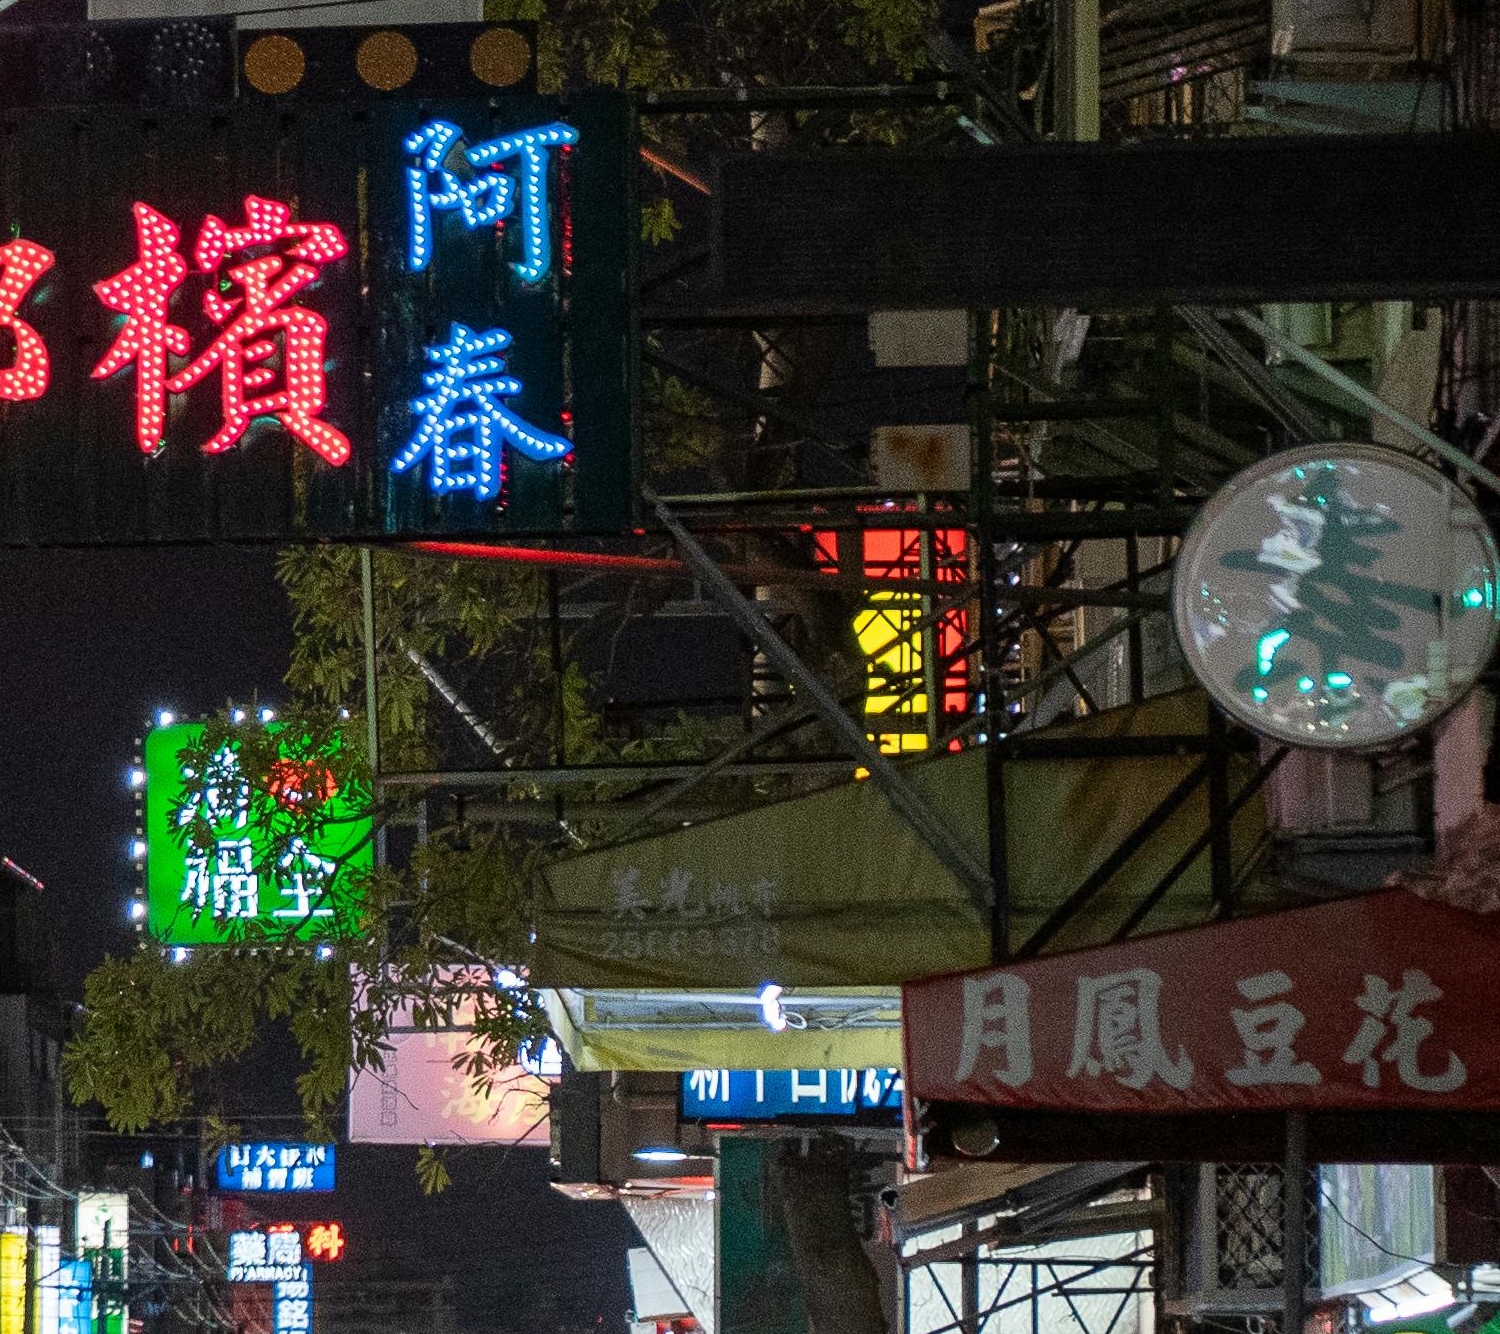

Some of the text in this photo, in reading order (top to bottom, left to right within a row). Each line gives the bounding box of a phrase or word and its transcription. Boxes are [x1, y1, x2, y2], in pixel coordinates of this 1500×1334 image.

[391, 118, 580, 502] 阿春
[955, 969, 1467, 1094] 月鳳豆花
